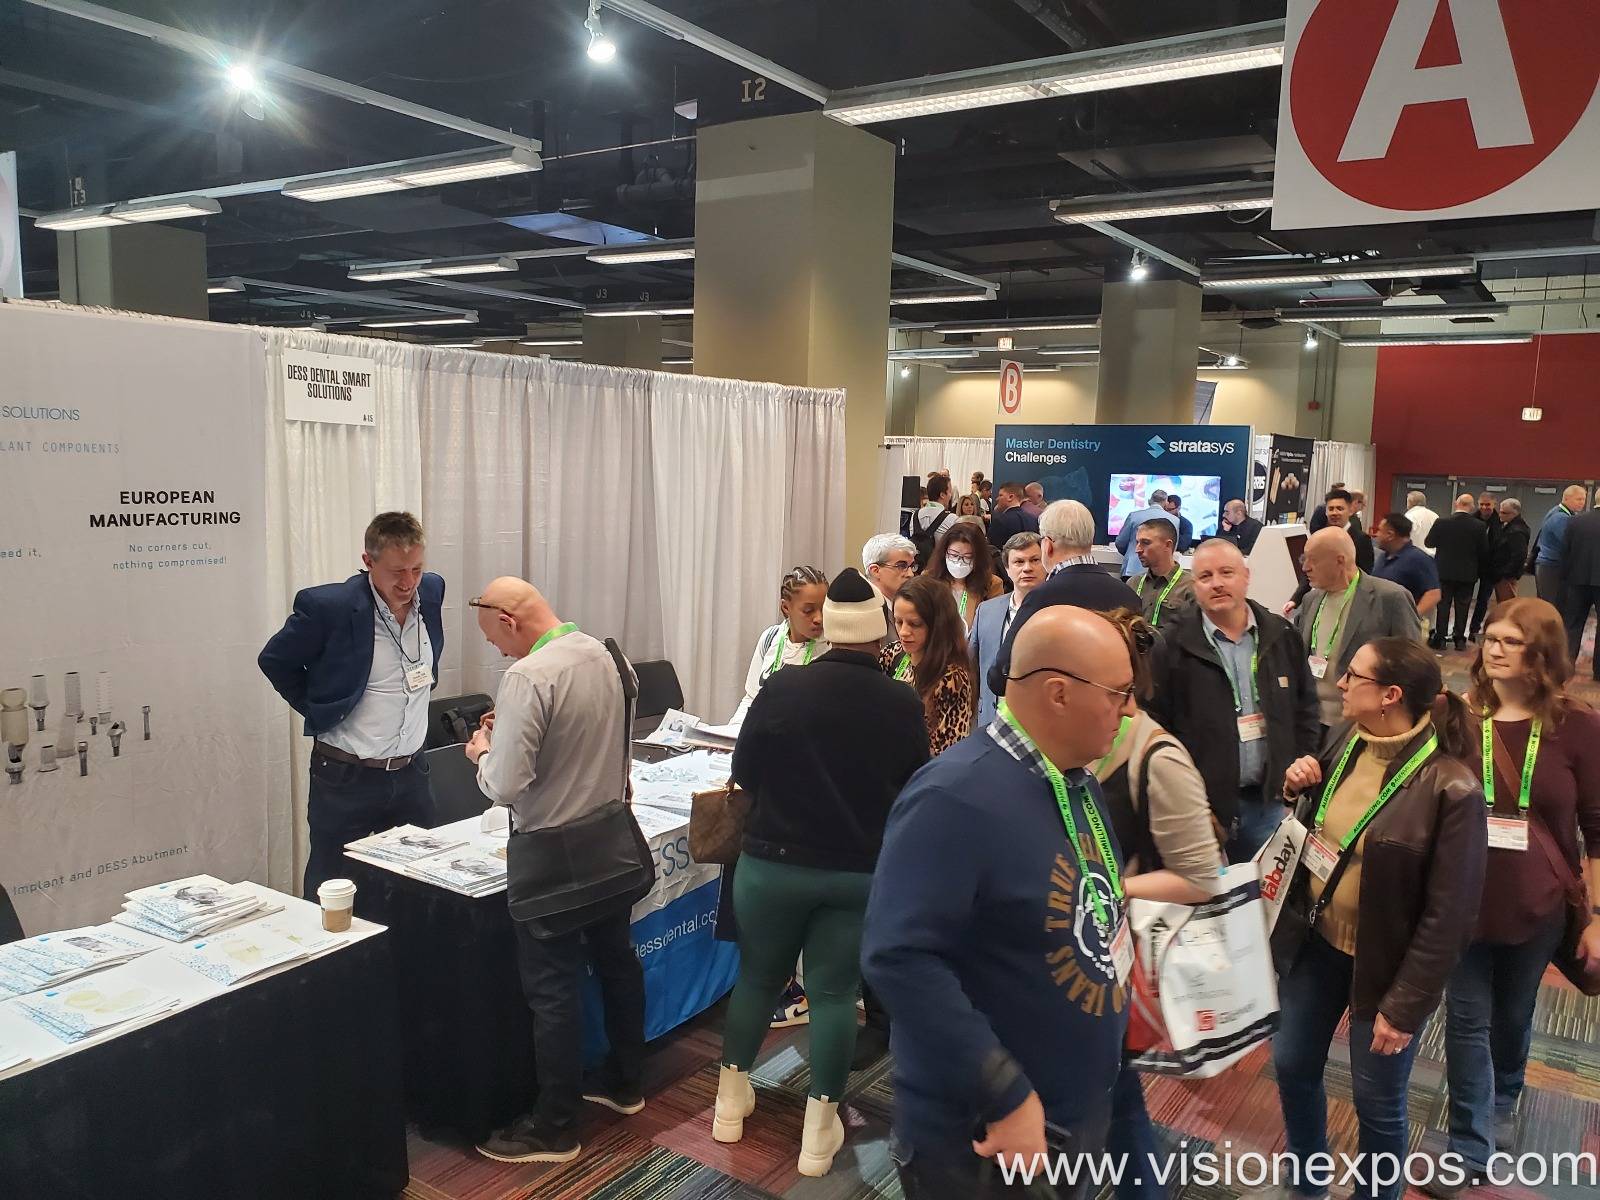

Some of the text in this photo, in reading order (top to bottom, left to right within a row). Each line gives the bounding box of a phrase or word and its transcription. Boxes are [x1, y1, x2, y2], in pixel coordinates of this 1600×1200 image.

[1336, 0, 1535, 163] A
[287, 364, 372, 388] DESS DENTAL SMART
[307, 382, 352, 402] SOLUTIONS
[1005, 368, 1019, 408] B
[2, 405, 80, 421] SOLUTIONS
[42, 442, 120, 454] COMPONENTS
[1005, 438, 1101, 452] Master Dentistry
[1168, 440, 1235, 456] stratasys
[1004, 451, 1067, 465] Challenges
[120, 490, 215, 505] EUROPEAN
[89, 511, 241, 528] MANUFACTURING
[129, 544, 143, 553] No
[147, 543, 188, 552] corners
[112, 556, 227, 570] nothing compromised!
[13, 845, 189, 897] Implant and DESS Abutment
